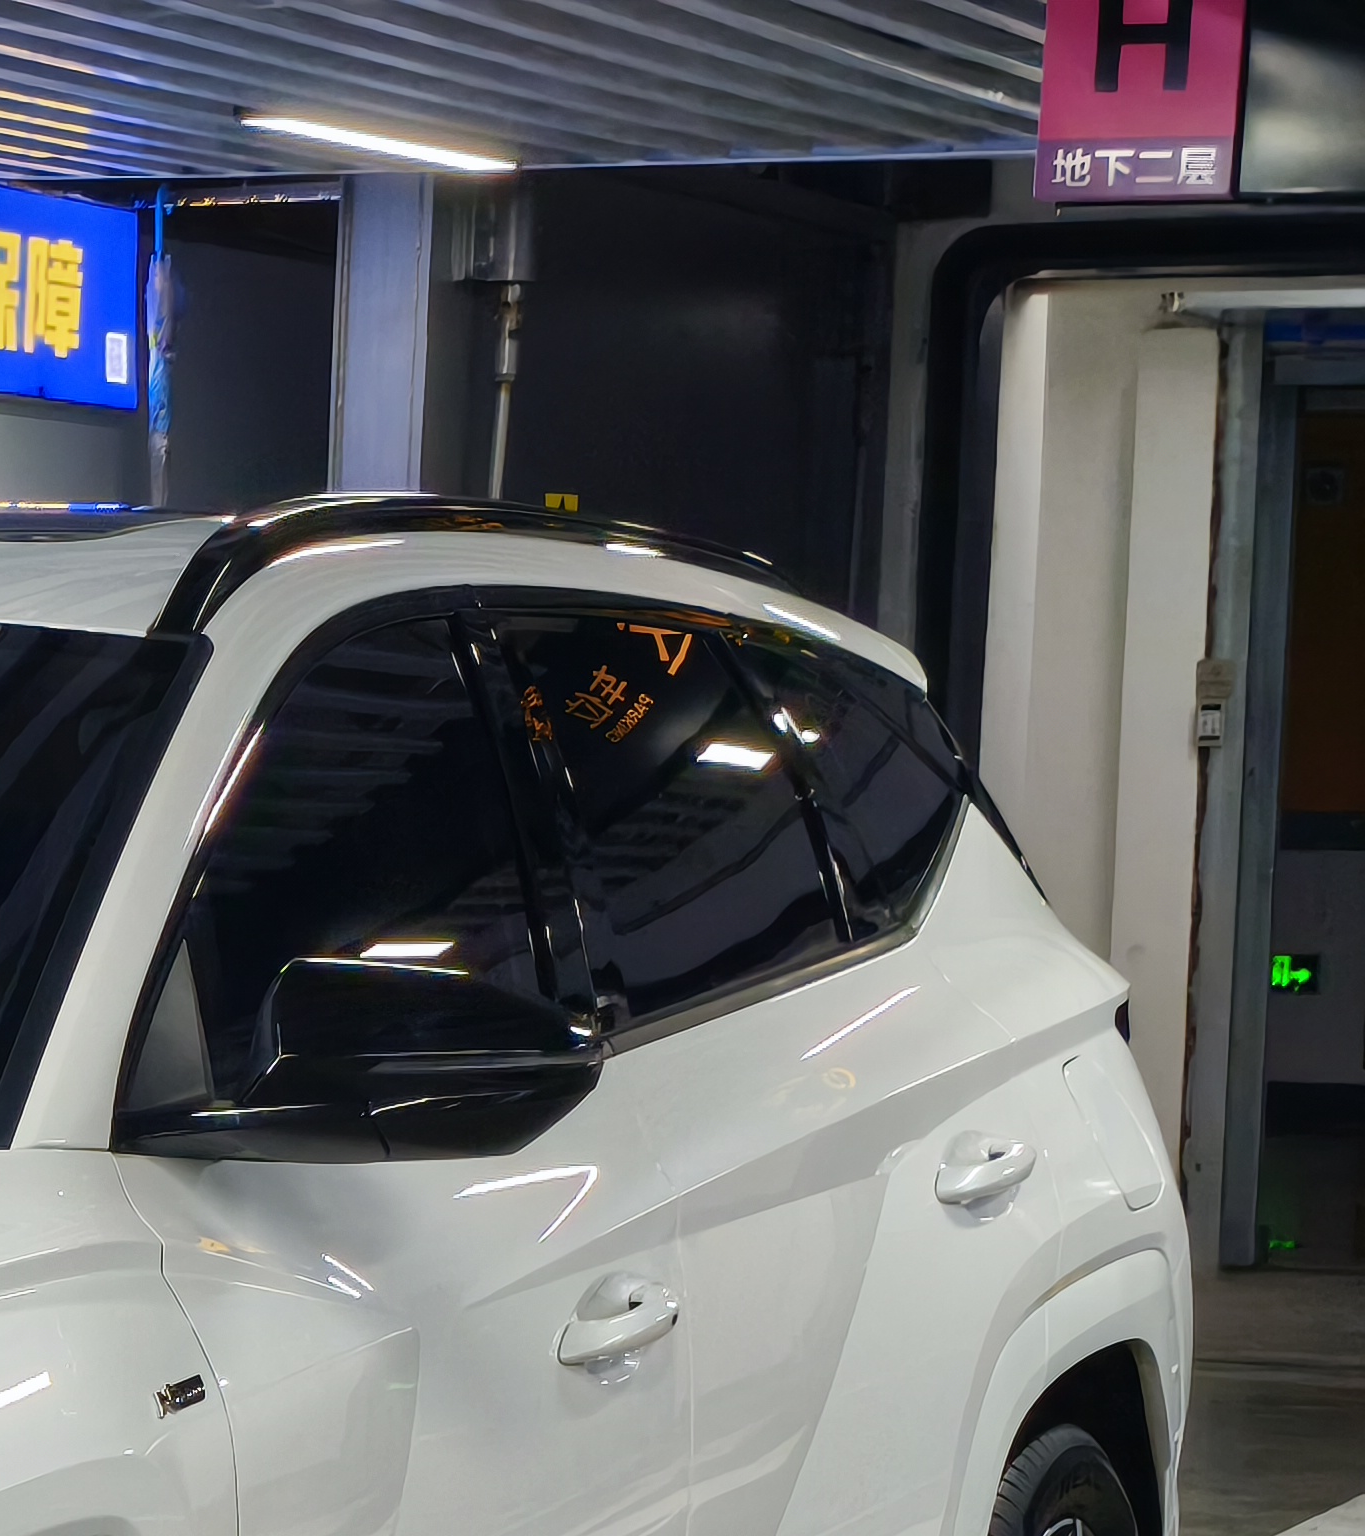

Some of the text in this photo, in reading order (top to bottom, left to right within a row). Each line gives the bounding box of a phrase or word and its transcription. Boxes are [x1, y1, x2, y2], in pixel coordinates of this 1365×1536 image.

[1094, 0, 1193, 92] H
[1051, 147, 1217, 188] 地下二层
